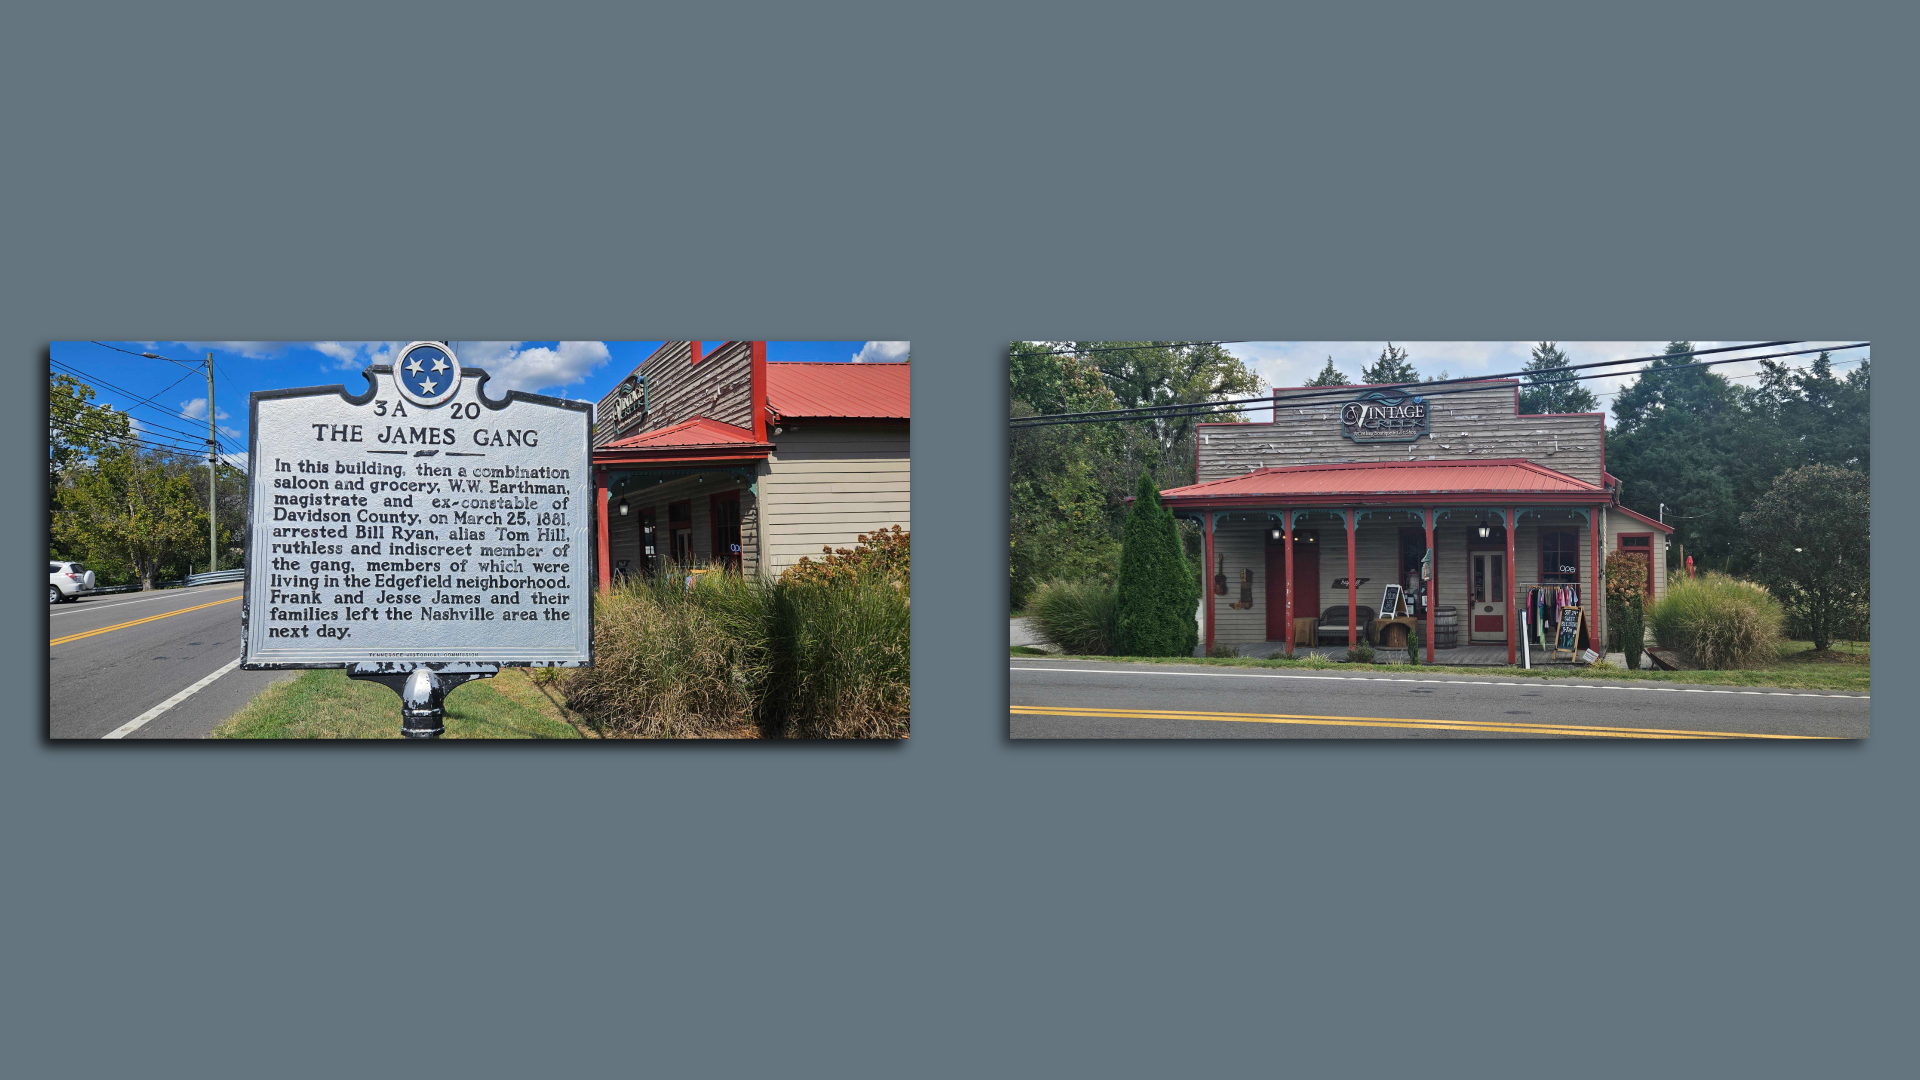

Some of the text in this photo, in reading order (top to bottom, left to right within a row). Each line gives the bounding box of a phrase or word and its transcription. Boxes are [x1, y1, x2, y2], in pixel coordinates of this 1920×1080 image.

[451, 402, 480, 419] 20
[1341, 402, 1425, 428] VINTAGE
[1364, 418, 1425, 429] CREEK
[312, 424, 538, 447] THE JAMES GANG
[276, 459, 291, 472] In
[298, 460, 328, 473] this
[416, 464, 451, 476] then
[458, 467, 467, 477] a
[473, 466, 570, 479] combination
[274, 476, 329, 489] saloon
[335, 477, 364, 490] and
[370, 481, 440, 494] grocery,
[489, 480, 569, 495] Earthman,
[274, 493, 569, 510] magistrate and ex-constable of
[273, 507, 351, 522] Davidson
[357, 509, 421, 526] County,
[429, 514, 448, 524] on
[454, 511, 502, 524] March
[507, 511, 530, 526] 25,
[273, 525, 569, 542] arrested Bill Ryan, alias Tom Hill,
[272, 541, 570, 557] ruthless and indiscreet member of
[272, 557, 569, 574] the gang, members of which were
[271, 574, 570, 593] living in the Edgefield neighborhood.
[270, 589, 569, 604] Frank and Jesse James and their
[270, 607, 570, 621] families left the Nashville area the
[269, 624, 351, 640] next day.
